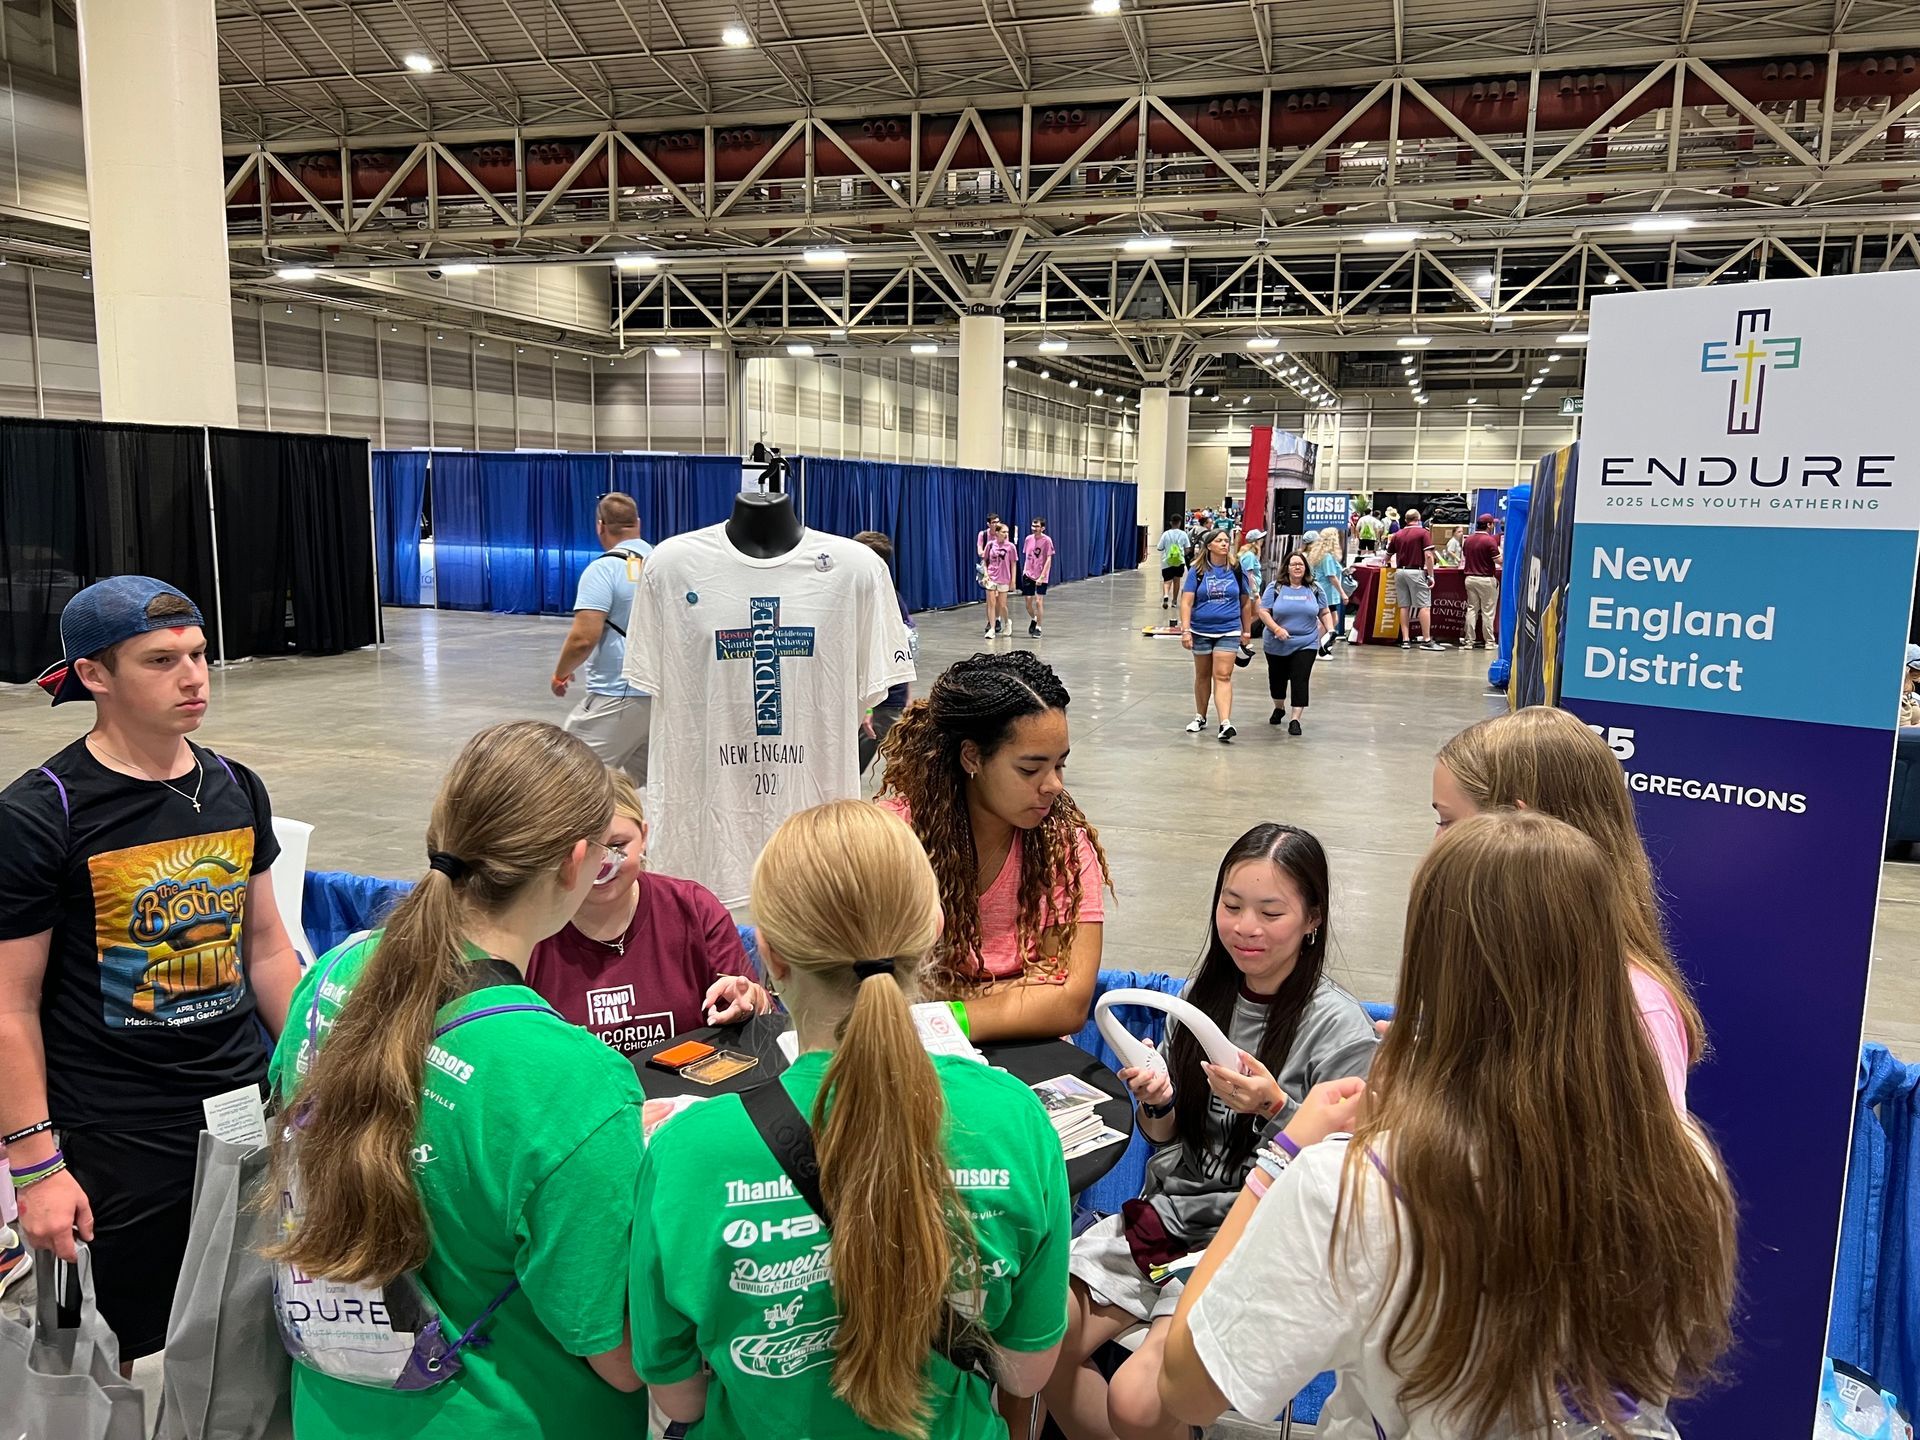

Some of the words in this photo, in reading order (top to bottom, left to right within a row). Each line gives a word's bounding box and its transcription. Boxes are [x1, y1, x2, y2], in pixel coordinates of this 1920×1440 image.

[1601, 456, 1895, 487] ENDURE
[1606, 497, 1644, 507] 2025
[1651, 497, 1695, 507] LCMS
[1703, 497, 1761, 509] YOUTH
[1769, 498, 1879, 510] GATHERING
[1592, 546, 1692, 582] New
[1588, 597, 1776, 642] England
[719, 631, 752, 640] Boston
[774, 630, 813, 638] Middletown
[775, 638, 810, 646] Ashaway
[719, 639, 753, 649] Niantic
[722, 648, 755, 660] Acton
[752, 607, 778, 728] ENDURE
[1584, 646, 1743, 692] District
[755, 773, 779, 795] 202
[157, 884, 179, 898] The
[176, 1005, 195, 1014] APRIL
[196, 1002, 203, 1010] 15
[593, 991, 630, 1007] STAND
[167, 1014, 195, 1026] Square
[196, 1008, 224, 1021] Garden
[594, 1004, 633, 1025] TALL
[725, 1174, 795, 1203] Thank
[737, 1281, 769, 1294] TOWING
[782, 1268, 829, 1291] RECOVERY
